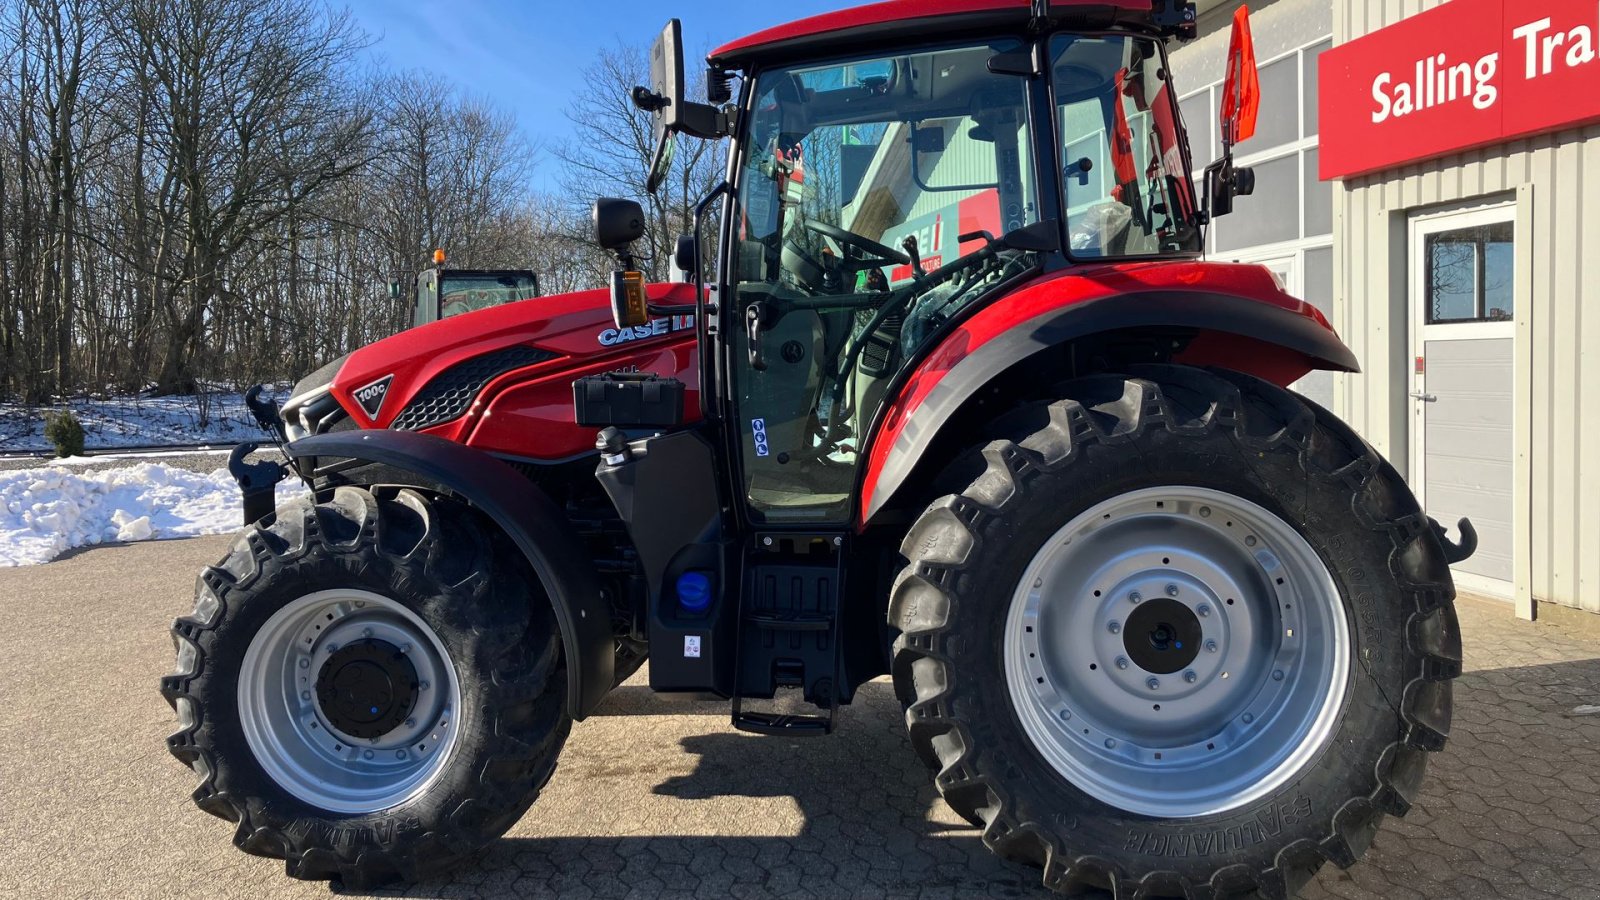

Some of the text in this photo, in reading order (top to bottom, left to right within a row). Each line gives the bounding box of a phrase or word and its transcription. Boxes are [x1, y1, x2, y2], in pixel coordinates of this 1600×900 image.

[1371, 16, 1600, 123] Salling Tra
[598, 316, 669, 346] CASE
[358, 384, 385, 402] 100c
